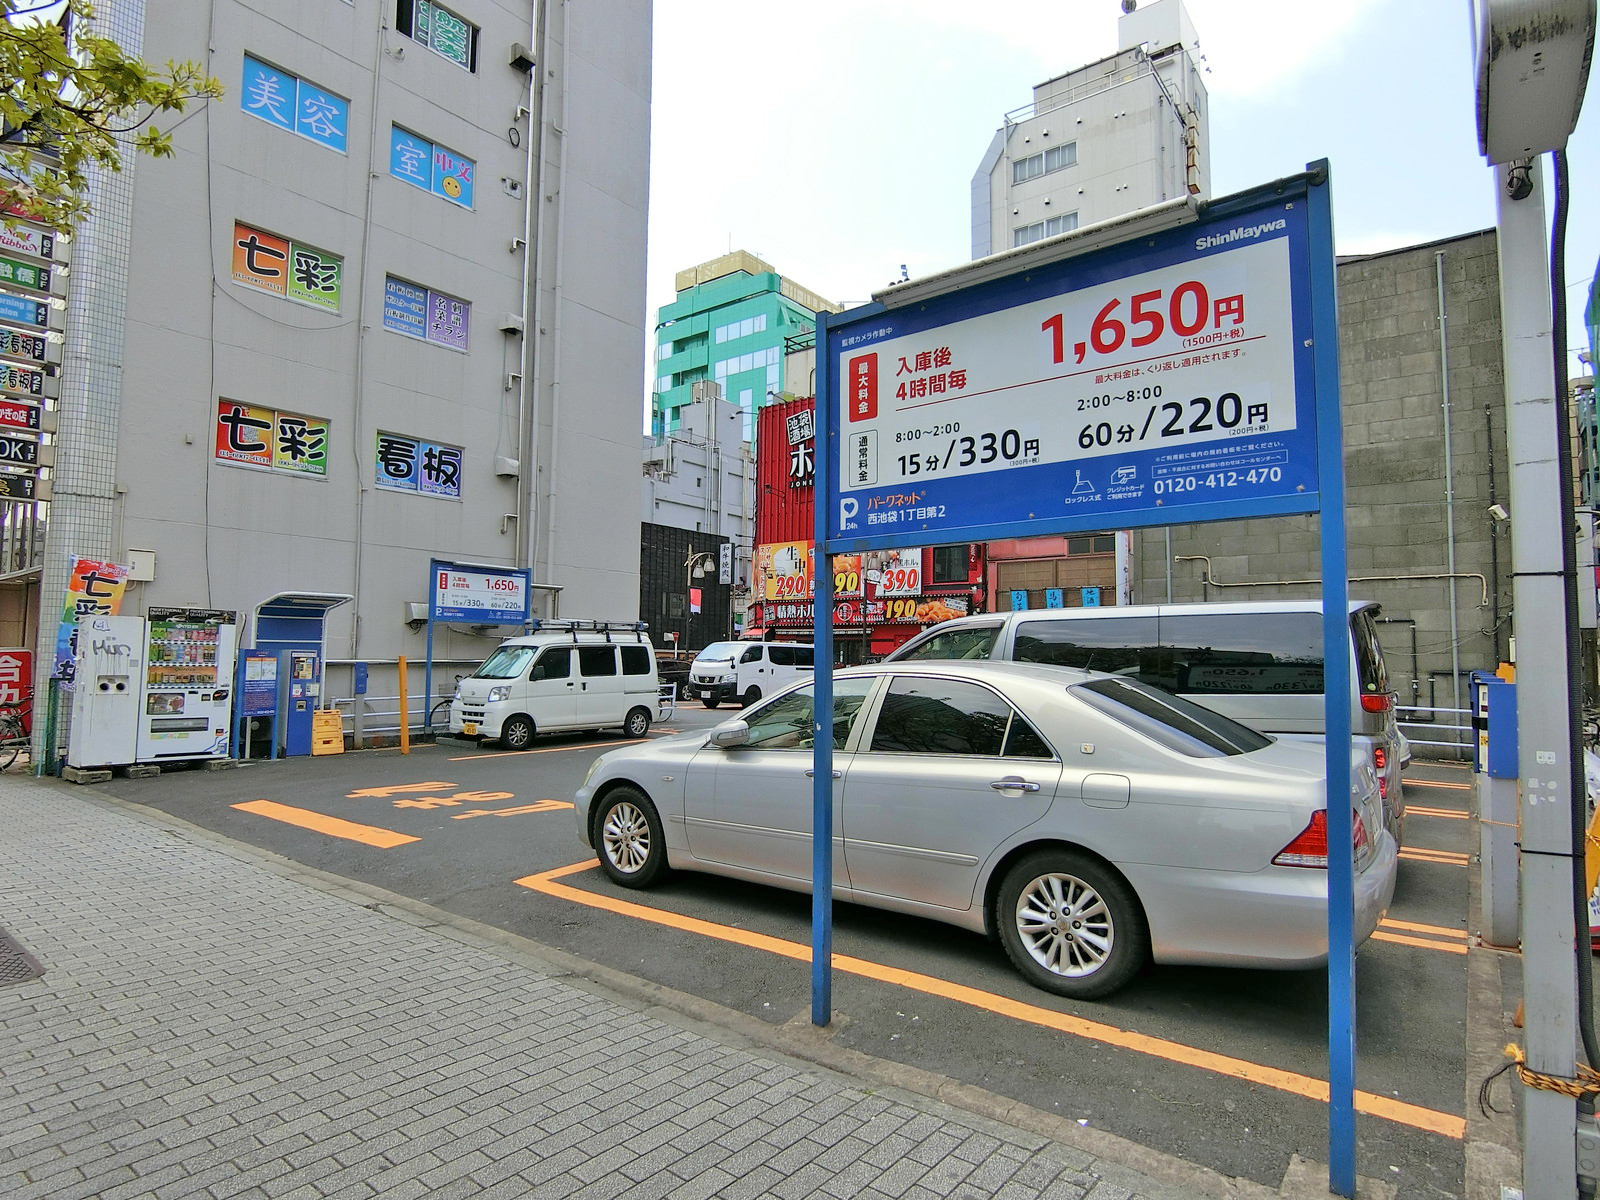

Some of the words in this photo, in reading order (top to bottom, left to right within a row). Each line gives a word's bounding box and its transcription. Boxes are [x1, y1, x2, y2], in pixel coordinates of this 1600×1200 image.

[248, 70, 344, 138] 美容
[395, 140, 427, 182] 室
[435, 153, 471, 183] 中文
[1195, 218, 1286, 251] ShinMaywa
[43, 239, 51, 255] 6F
[237, 234, 337, 293] 七彩
[40, 273, 48, 288] 5F
[38, 307, 45, 322] 4F
[432, 322, 466, 339] チラシ
[841, 327, 893, 347] 監視カメラ作動中
[35, 342, 43, 357] 3F
[896, 346, 952, 378] 入庫後
[1094, 348, 1247, 385] 最大料金は、くり返し適用されます。
[32, 376, 41, 391] 2F
[858, 362, 869, 414] 最大料金
[896, 369, 967, 401] 4時間毎
[30, 410, 37, 426] 1F
[789, 412, 810, 430] 池袋
[219, 406, 325, 460] 七彩
[790, 425, 811, 442] 酒場
[28, 445, 35, 460] 1F
[378, 437, 460, 488] 看板
[789, 443, 815, 478] ホ
[858, 436, 868, 483] 通常料金
[25, 480, 33, 495] B1
[1106, 484, 1145, 494] クレジットカード
[1154, 467, 1282, 494] 0120-412-470
[1064, 493, 1102, 504] ロックレス式
[1106, 491, 1143, 500] ご利用できます
[867, 505, 946, 525] 西池袋1丁目第2
[775, 576, 805, 597] 290
[833, 571, 858, 593] 90
[883, 569, 919, 592] 390
[886, 600, 917, 618] 190
